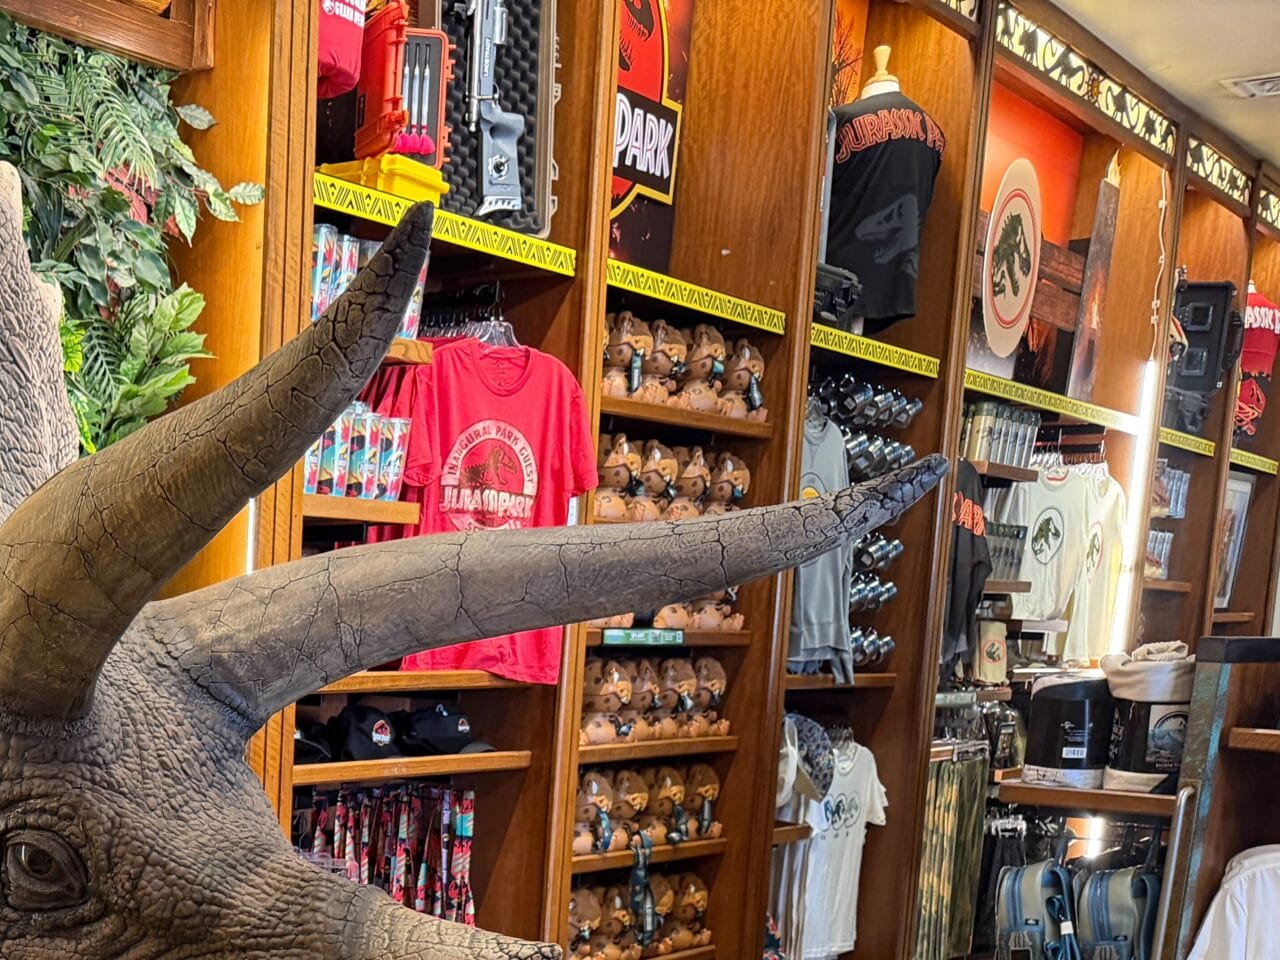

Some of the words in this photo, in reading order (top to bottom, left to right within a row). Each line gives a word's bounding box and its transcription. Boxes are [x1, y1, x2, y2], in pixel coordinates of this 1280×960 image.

[613, 92, 673, 179] PARK
[835, 108, 926, 164] JURASSIC
[447, 425, 492, 476] INAUGURAL
[495, 426, 520, 446] PARK
[519, 446, 535, 485] GUEST
[497, 491, 535, 518] PARK
